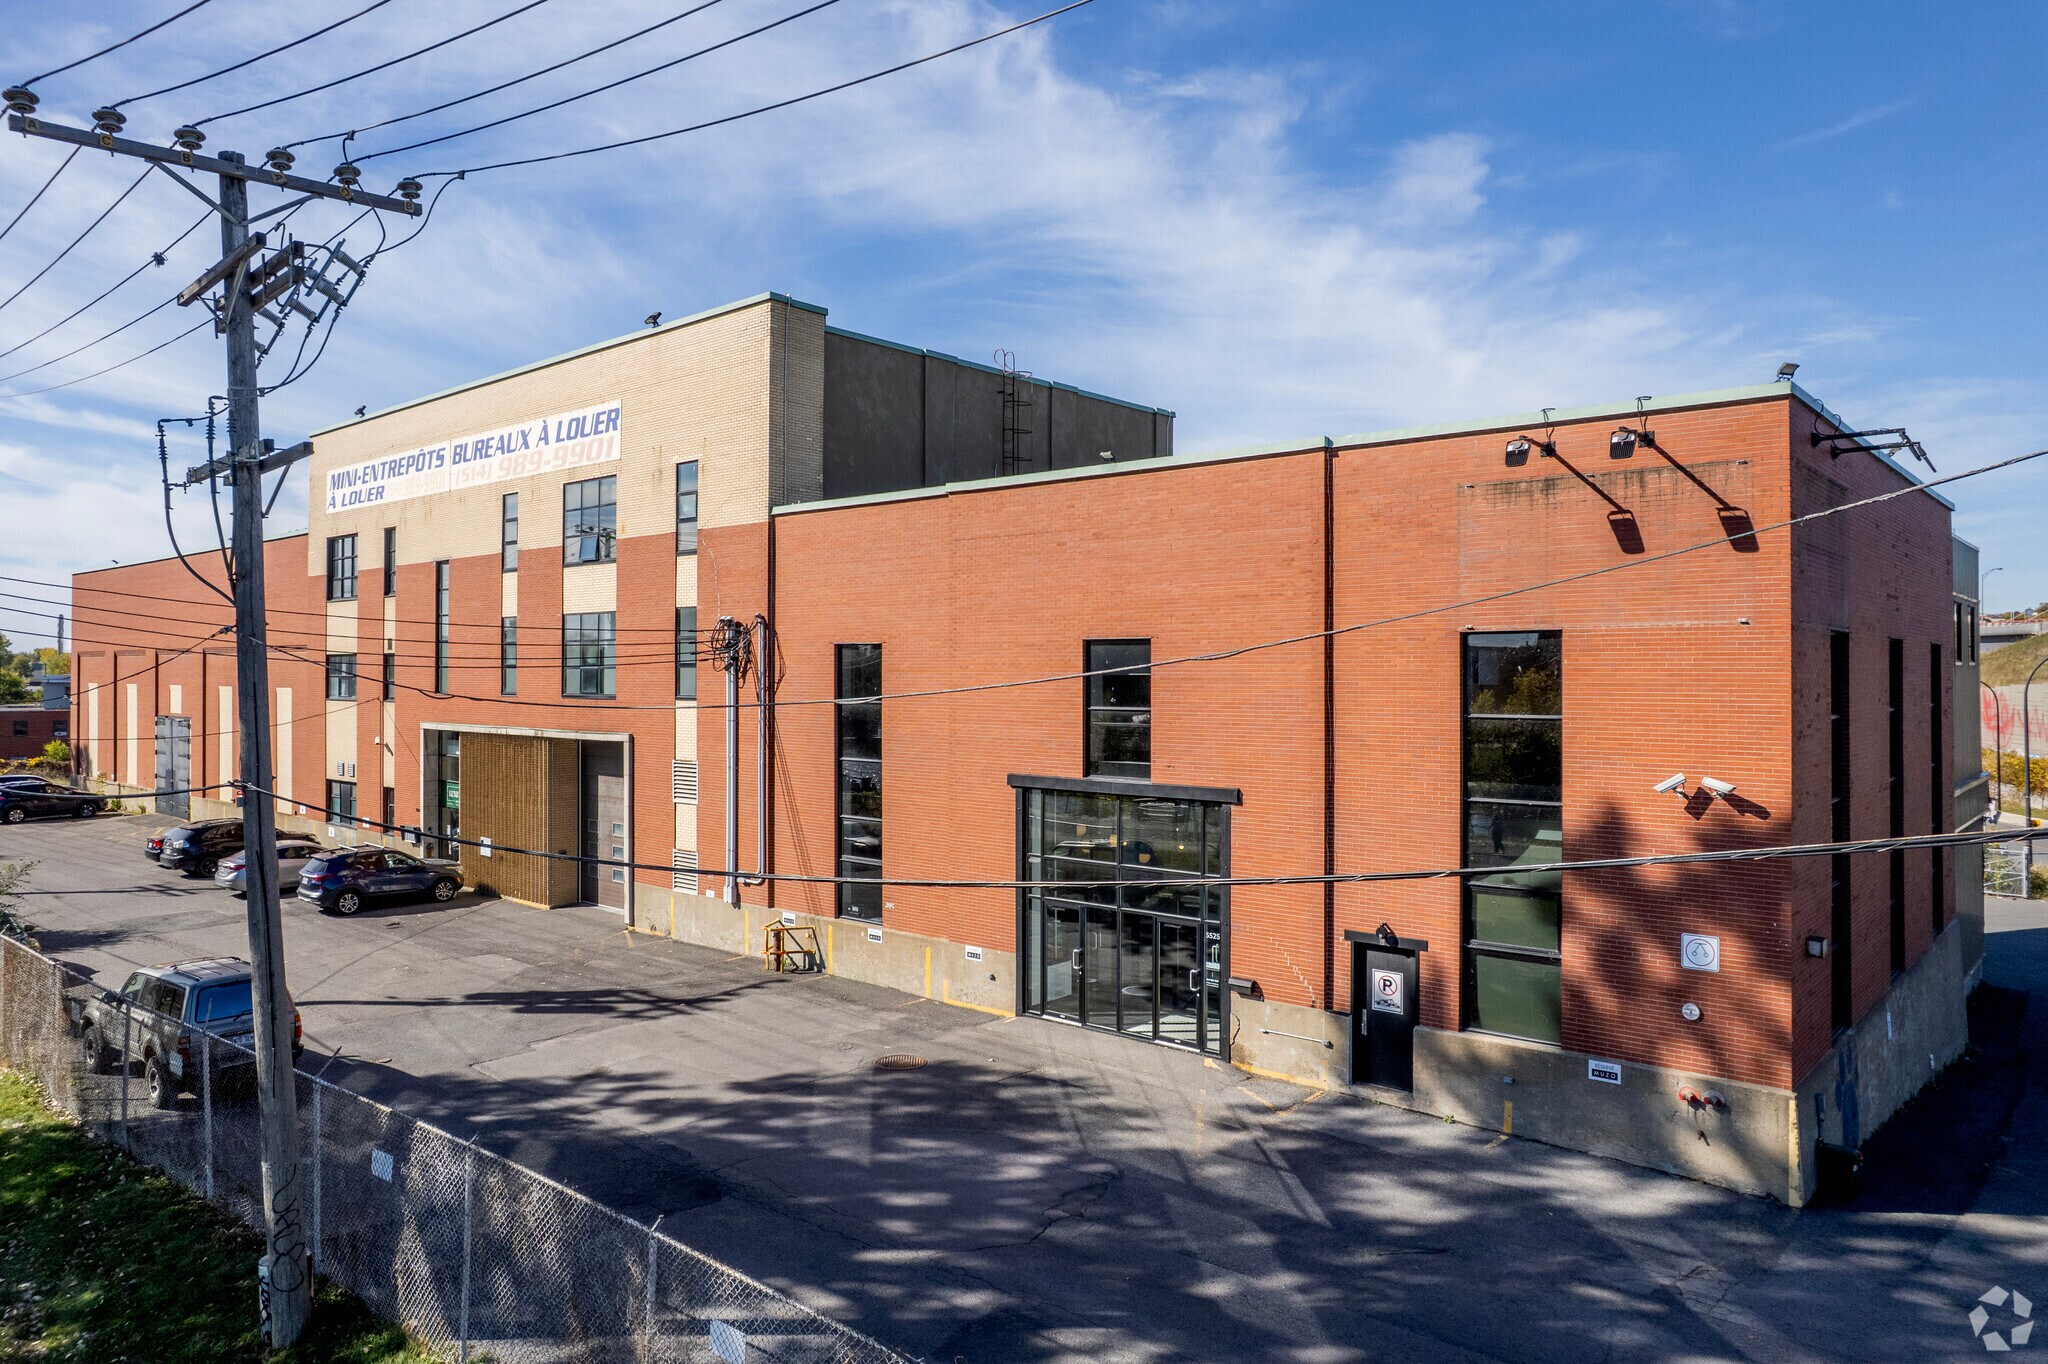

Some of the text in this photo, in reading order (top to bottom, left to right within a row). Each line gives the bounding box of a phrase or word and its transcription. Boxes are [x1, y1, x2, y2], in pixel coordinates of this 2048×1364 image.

[27, 120, 38, 129] A
[101, 135, 112, 146] C
[182, 154, 191, 163] B
[405, 202, 413, 211] B
[452, 407, 620, 465] BUREAUX À LOUER
[456, 435, 615, 487] (514) 989-9901
[330, 447, 446, 491] MINI-ENTREPÔTS
[327, 492, 336, 510] À
[341, 485, 385, 508] LOUER
[1382, 978, 1393, 992] P
[1593, 1070, 1616, 1080] MUZO
